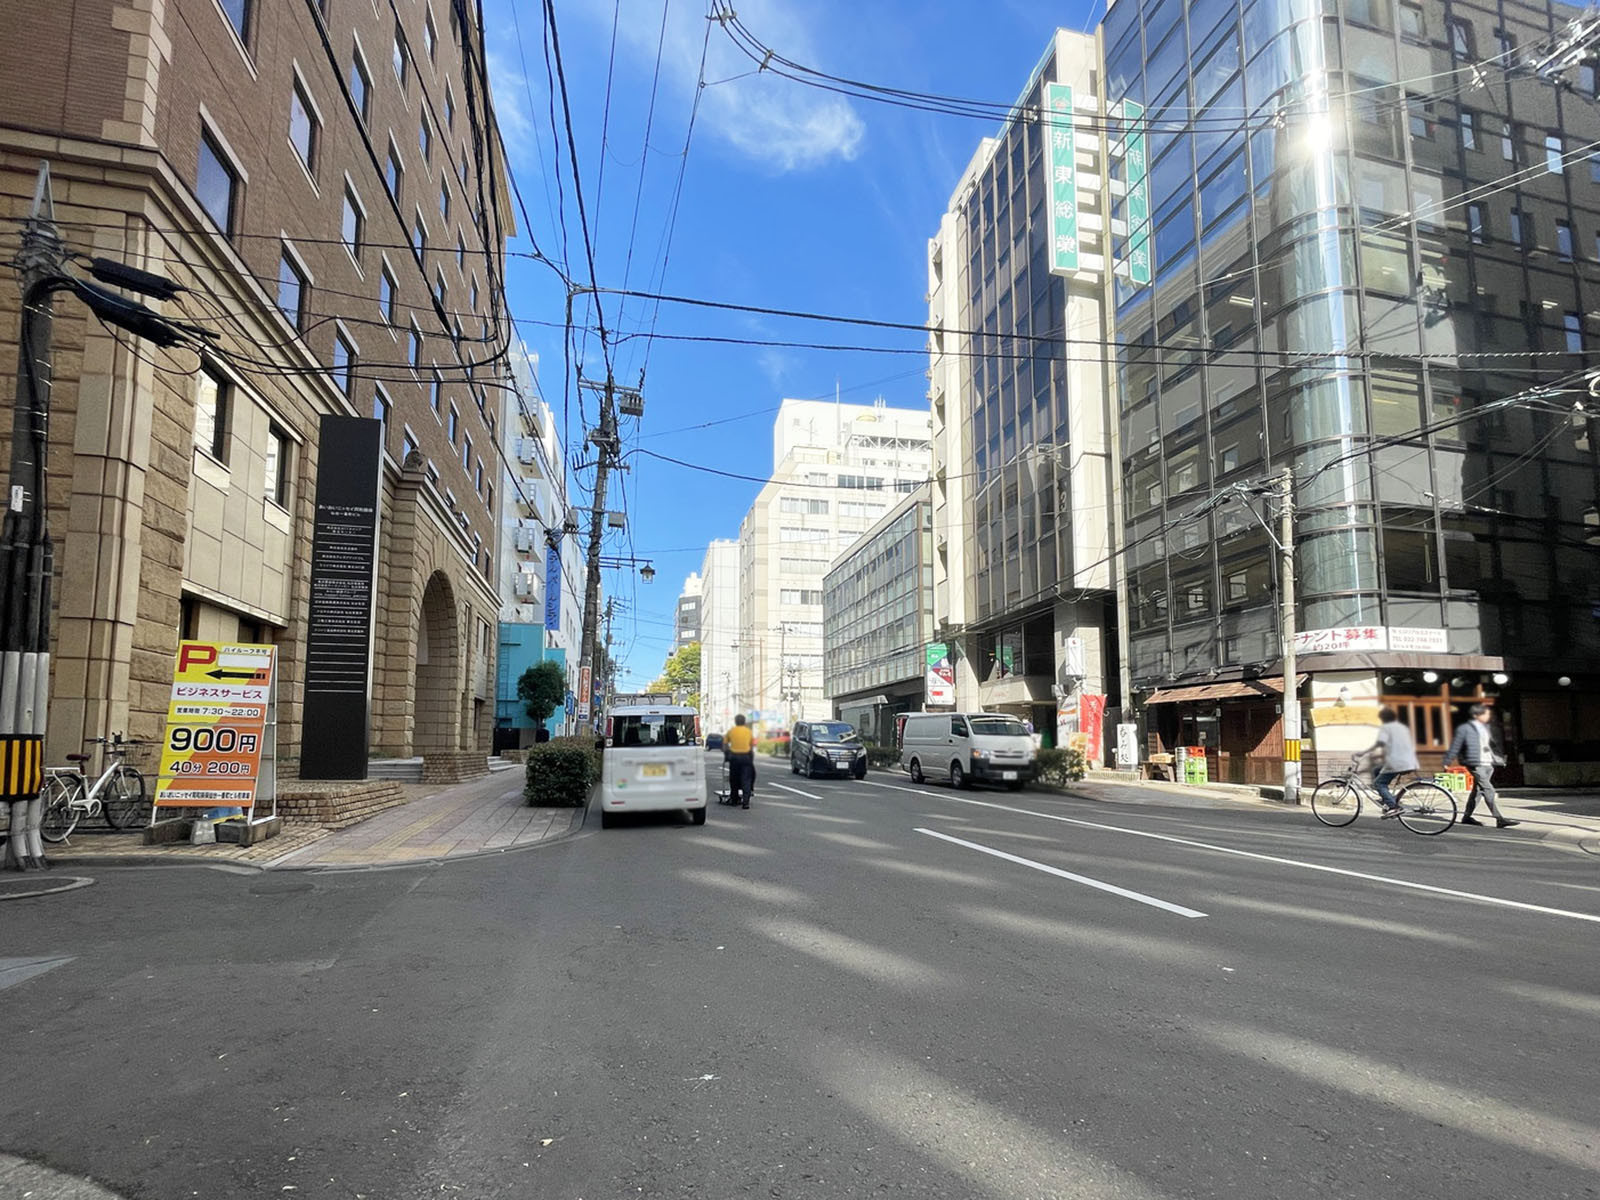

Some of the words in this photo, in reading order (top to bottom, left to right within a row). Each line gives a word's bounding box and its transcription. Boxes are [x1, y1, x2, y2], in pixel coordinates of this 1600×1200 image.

[1053, 130, 1076, 254] 新東総業
[178, 644, 218, 673] P
[223, 647, 267, 655] ハイルーフ不可
[176, 686, 263, 699] ビジネスサービス
[170, 727, 257, 752] 900円
[169, 761, 202, 773] 40分
[207, 761, 250, 774] 200円
